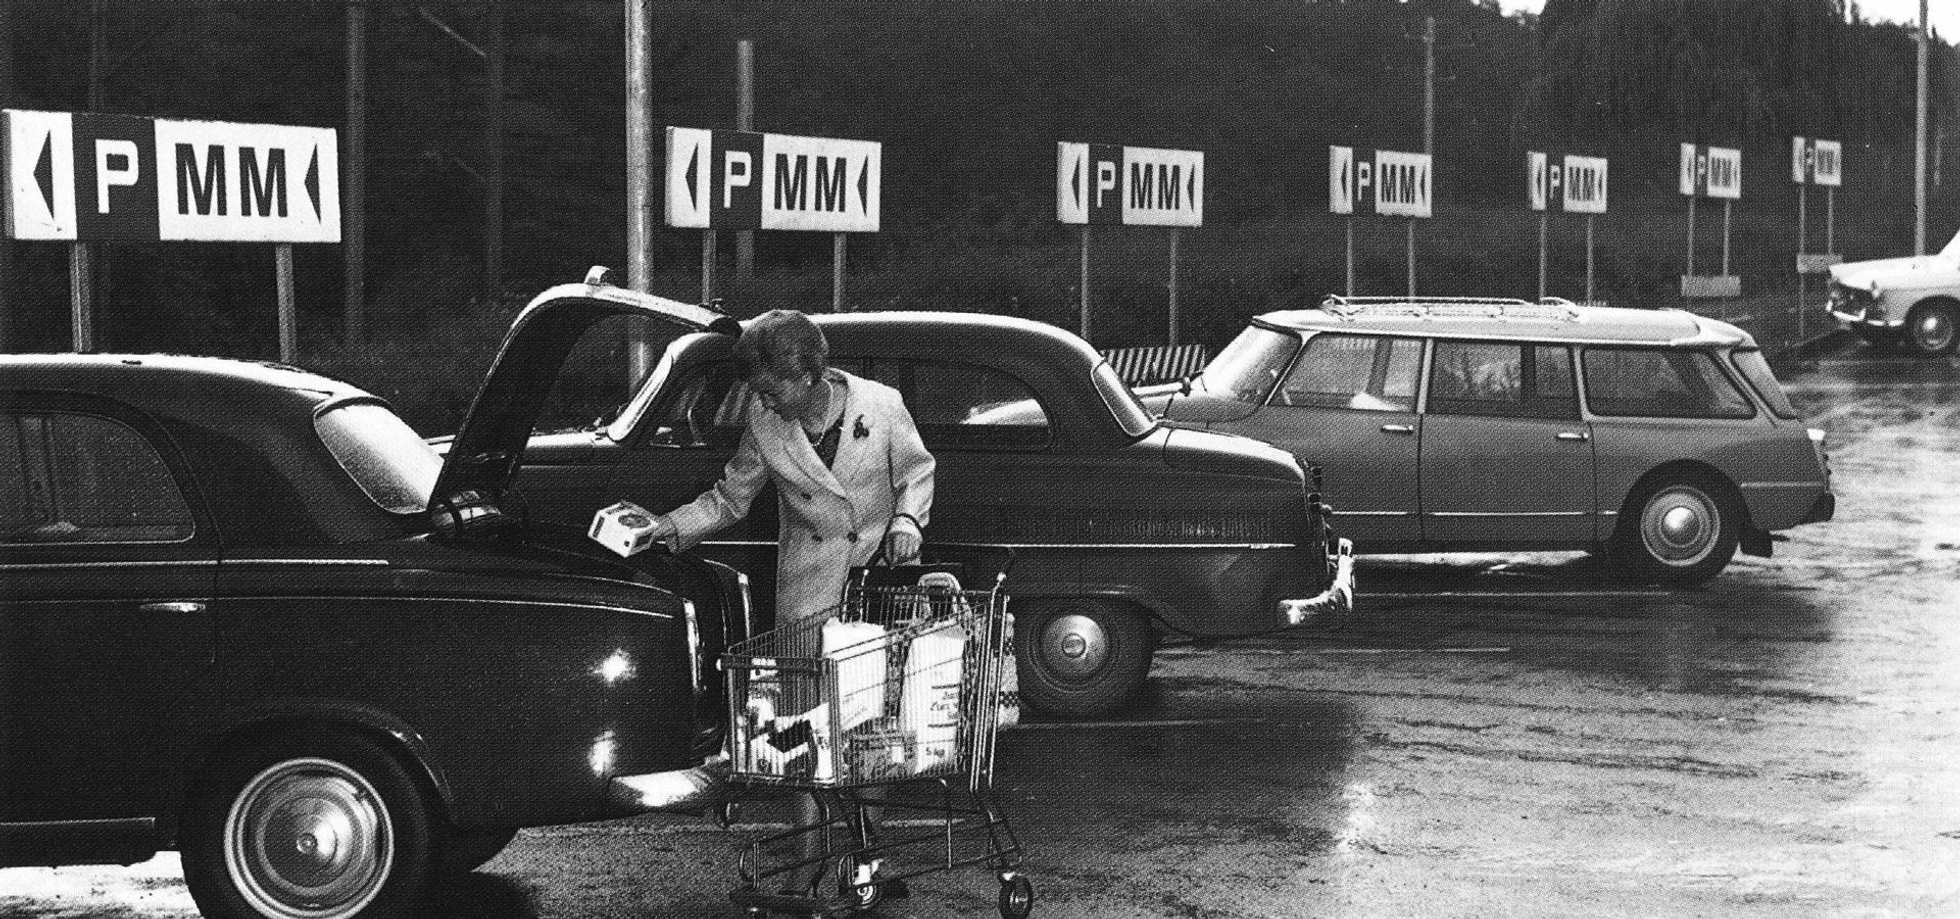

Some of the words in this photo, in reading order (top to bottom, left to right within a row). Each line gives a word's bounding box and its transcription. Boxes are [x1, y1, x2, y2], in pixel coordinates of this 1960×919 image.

[95, 139, 140, 214] P
[175, 143, 288, 218] MM
[723, 150, 752, 208] P
[774, 153, 847, 213] MM
[1097, 161, 1116, 208] P
[1130, 162, 1180, 210] MM
[1358, 161, 1371, 201] P
[1381, 163, 1415, 205] MM
[1550, 165, 1560, 200] P
[1568, 166, 1595, 201] MM
